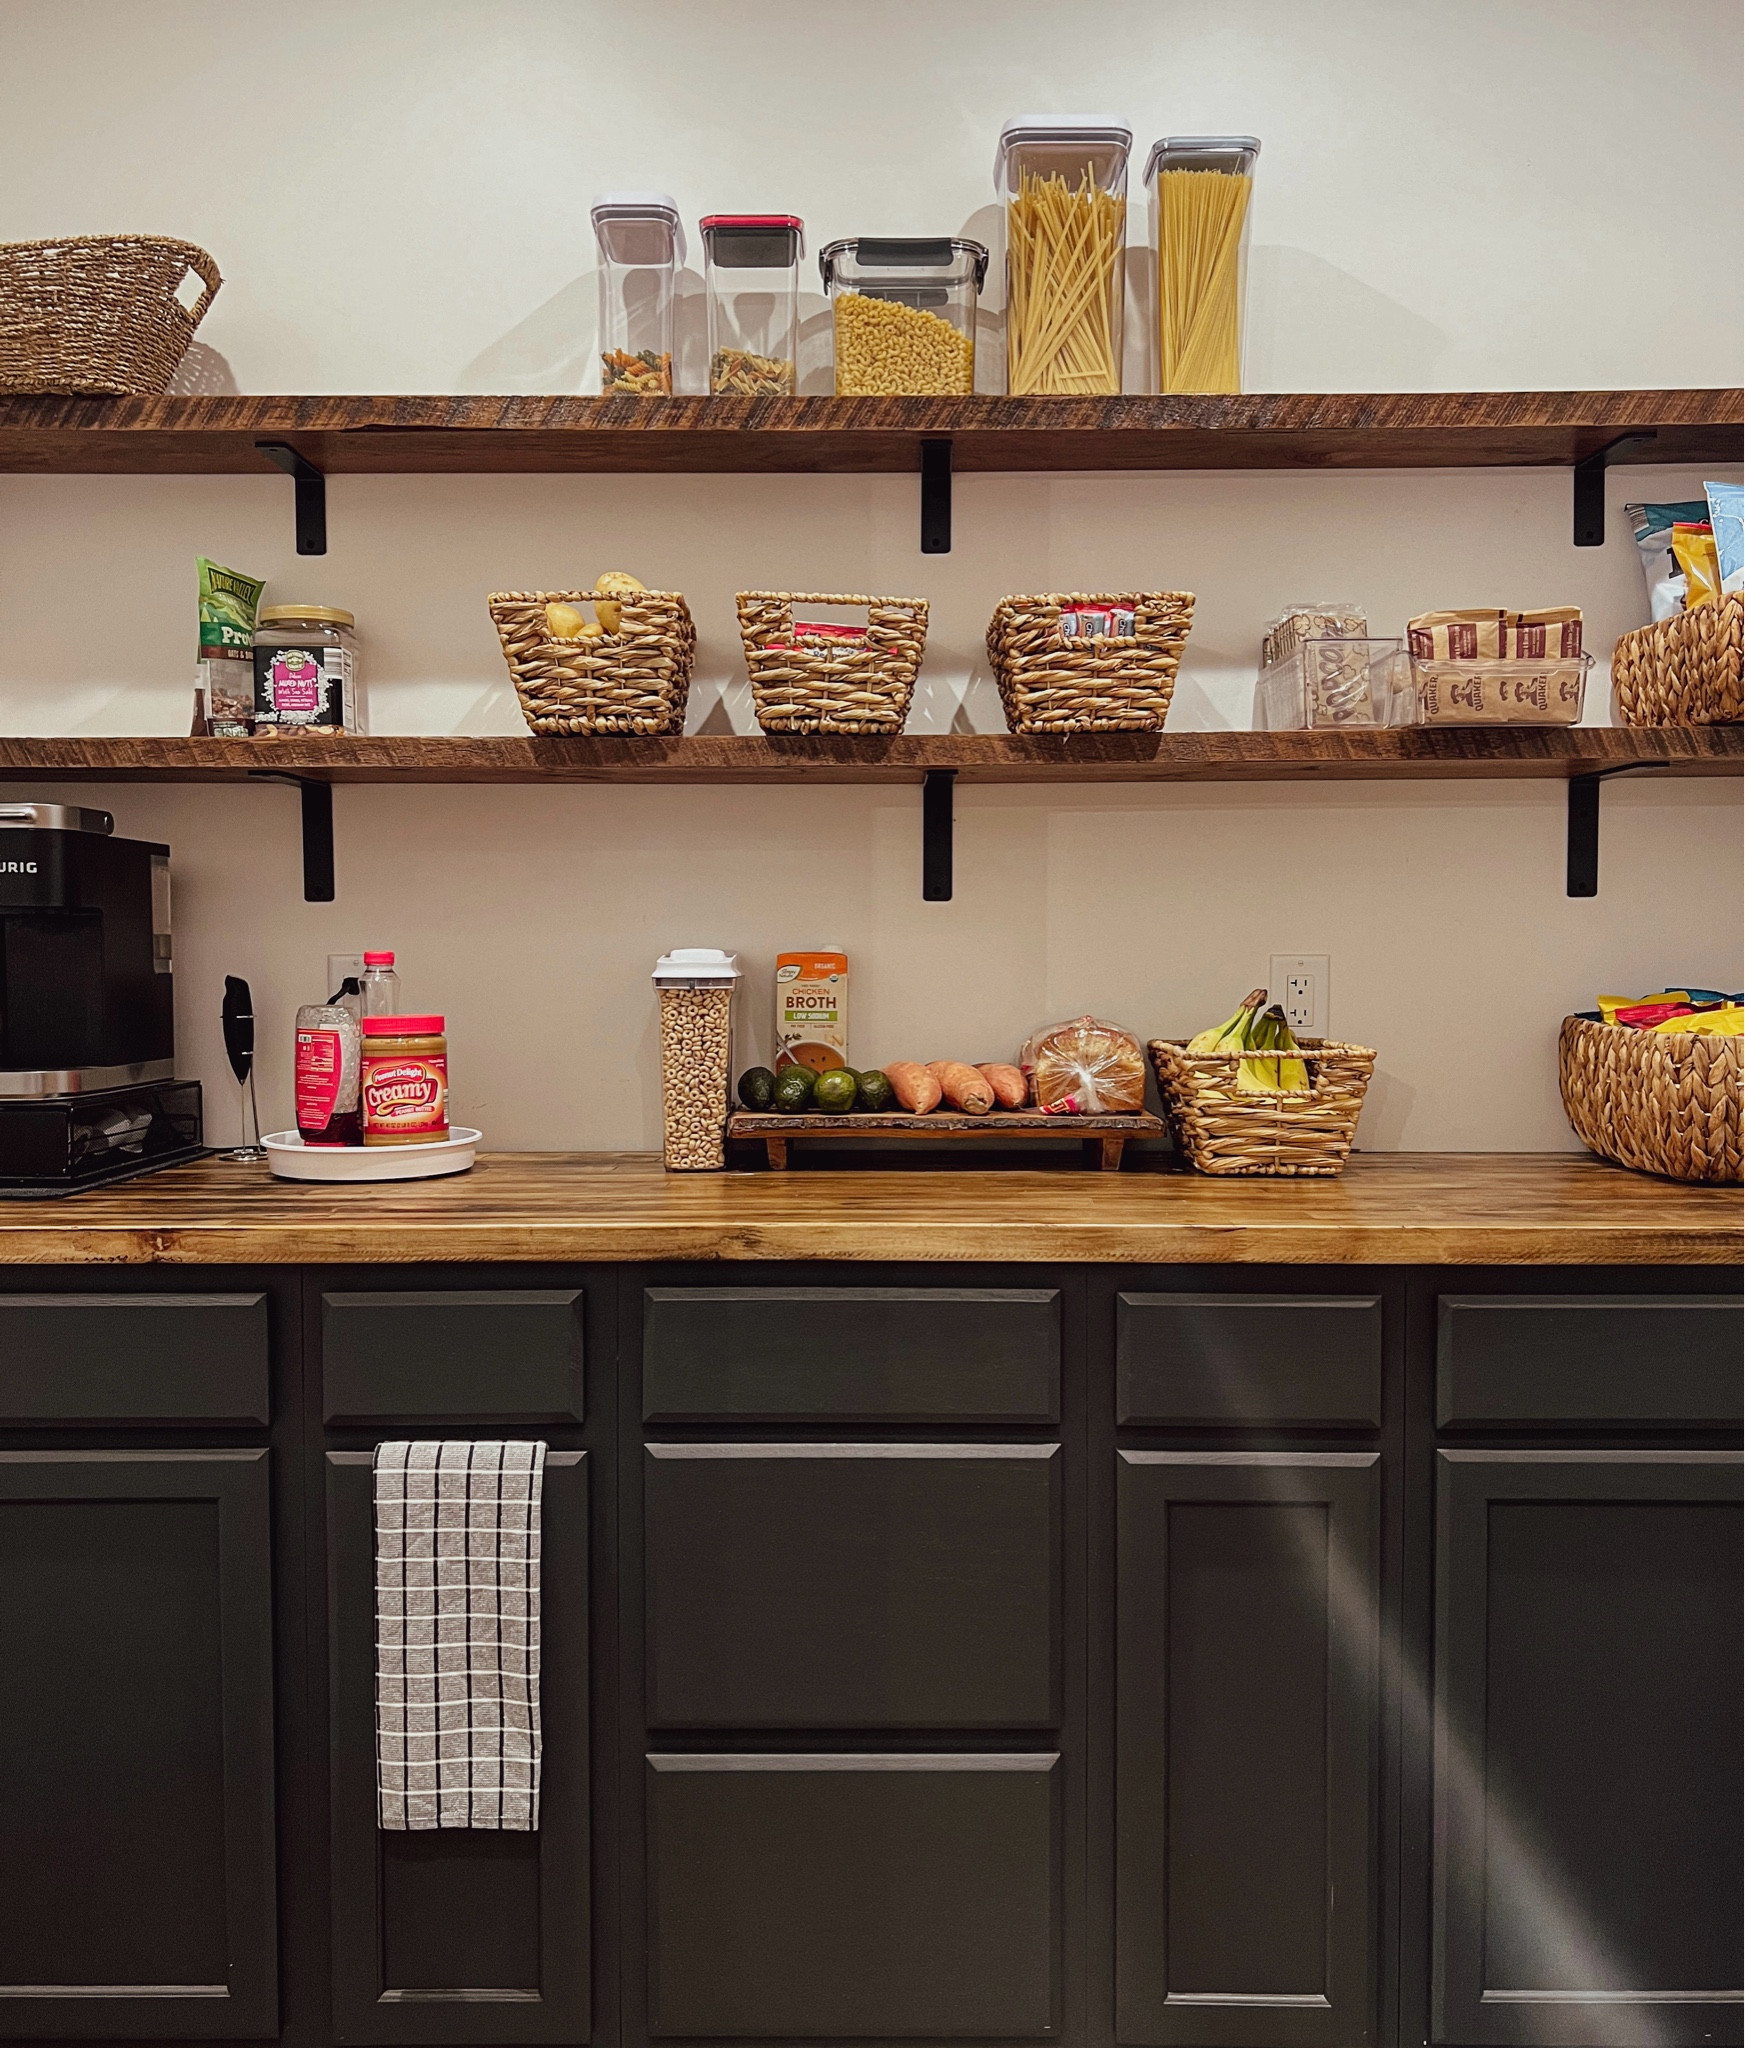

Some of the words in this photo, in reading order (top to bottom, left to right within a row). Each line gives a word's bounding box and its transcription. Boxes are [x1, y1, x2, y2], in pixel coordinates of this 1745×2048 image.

[1429, 675, 1440, 715] QUAKER
[786, 996, 837, 1009] BROTH
[793, 1012, 807, 1020] LOW
[397, 1067, 423, 1078] Delight
[368, 1082, 432, 1107] Creamy
